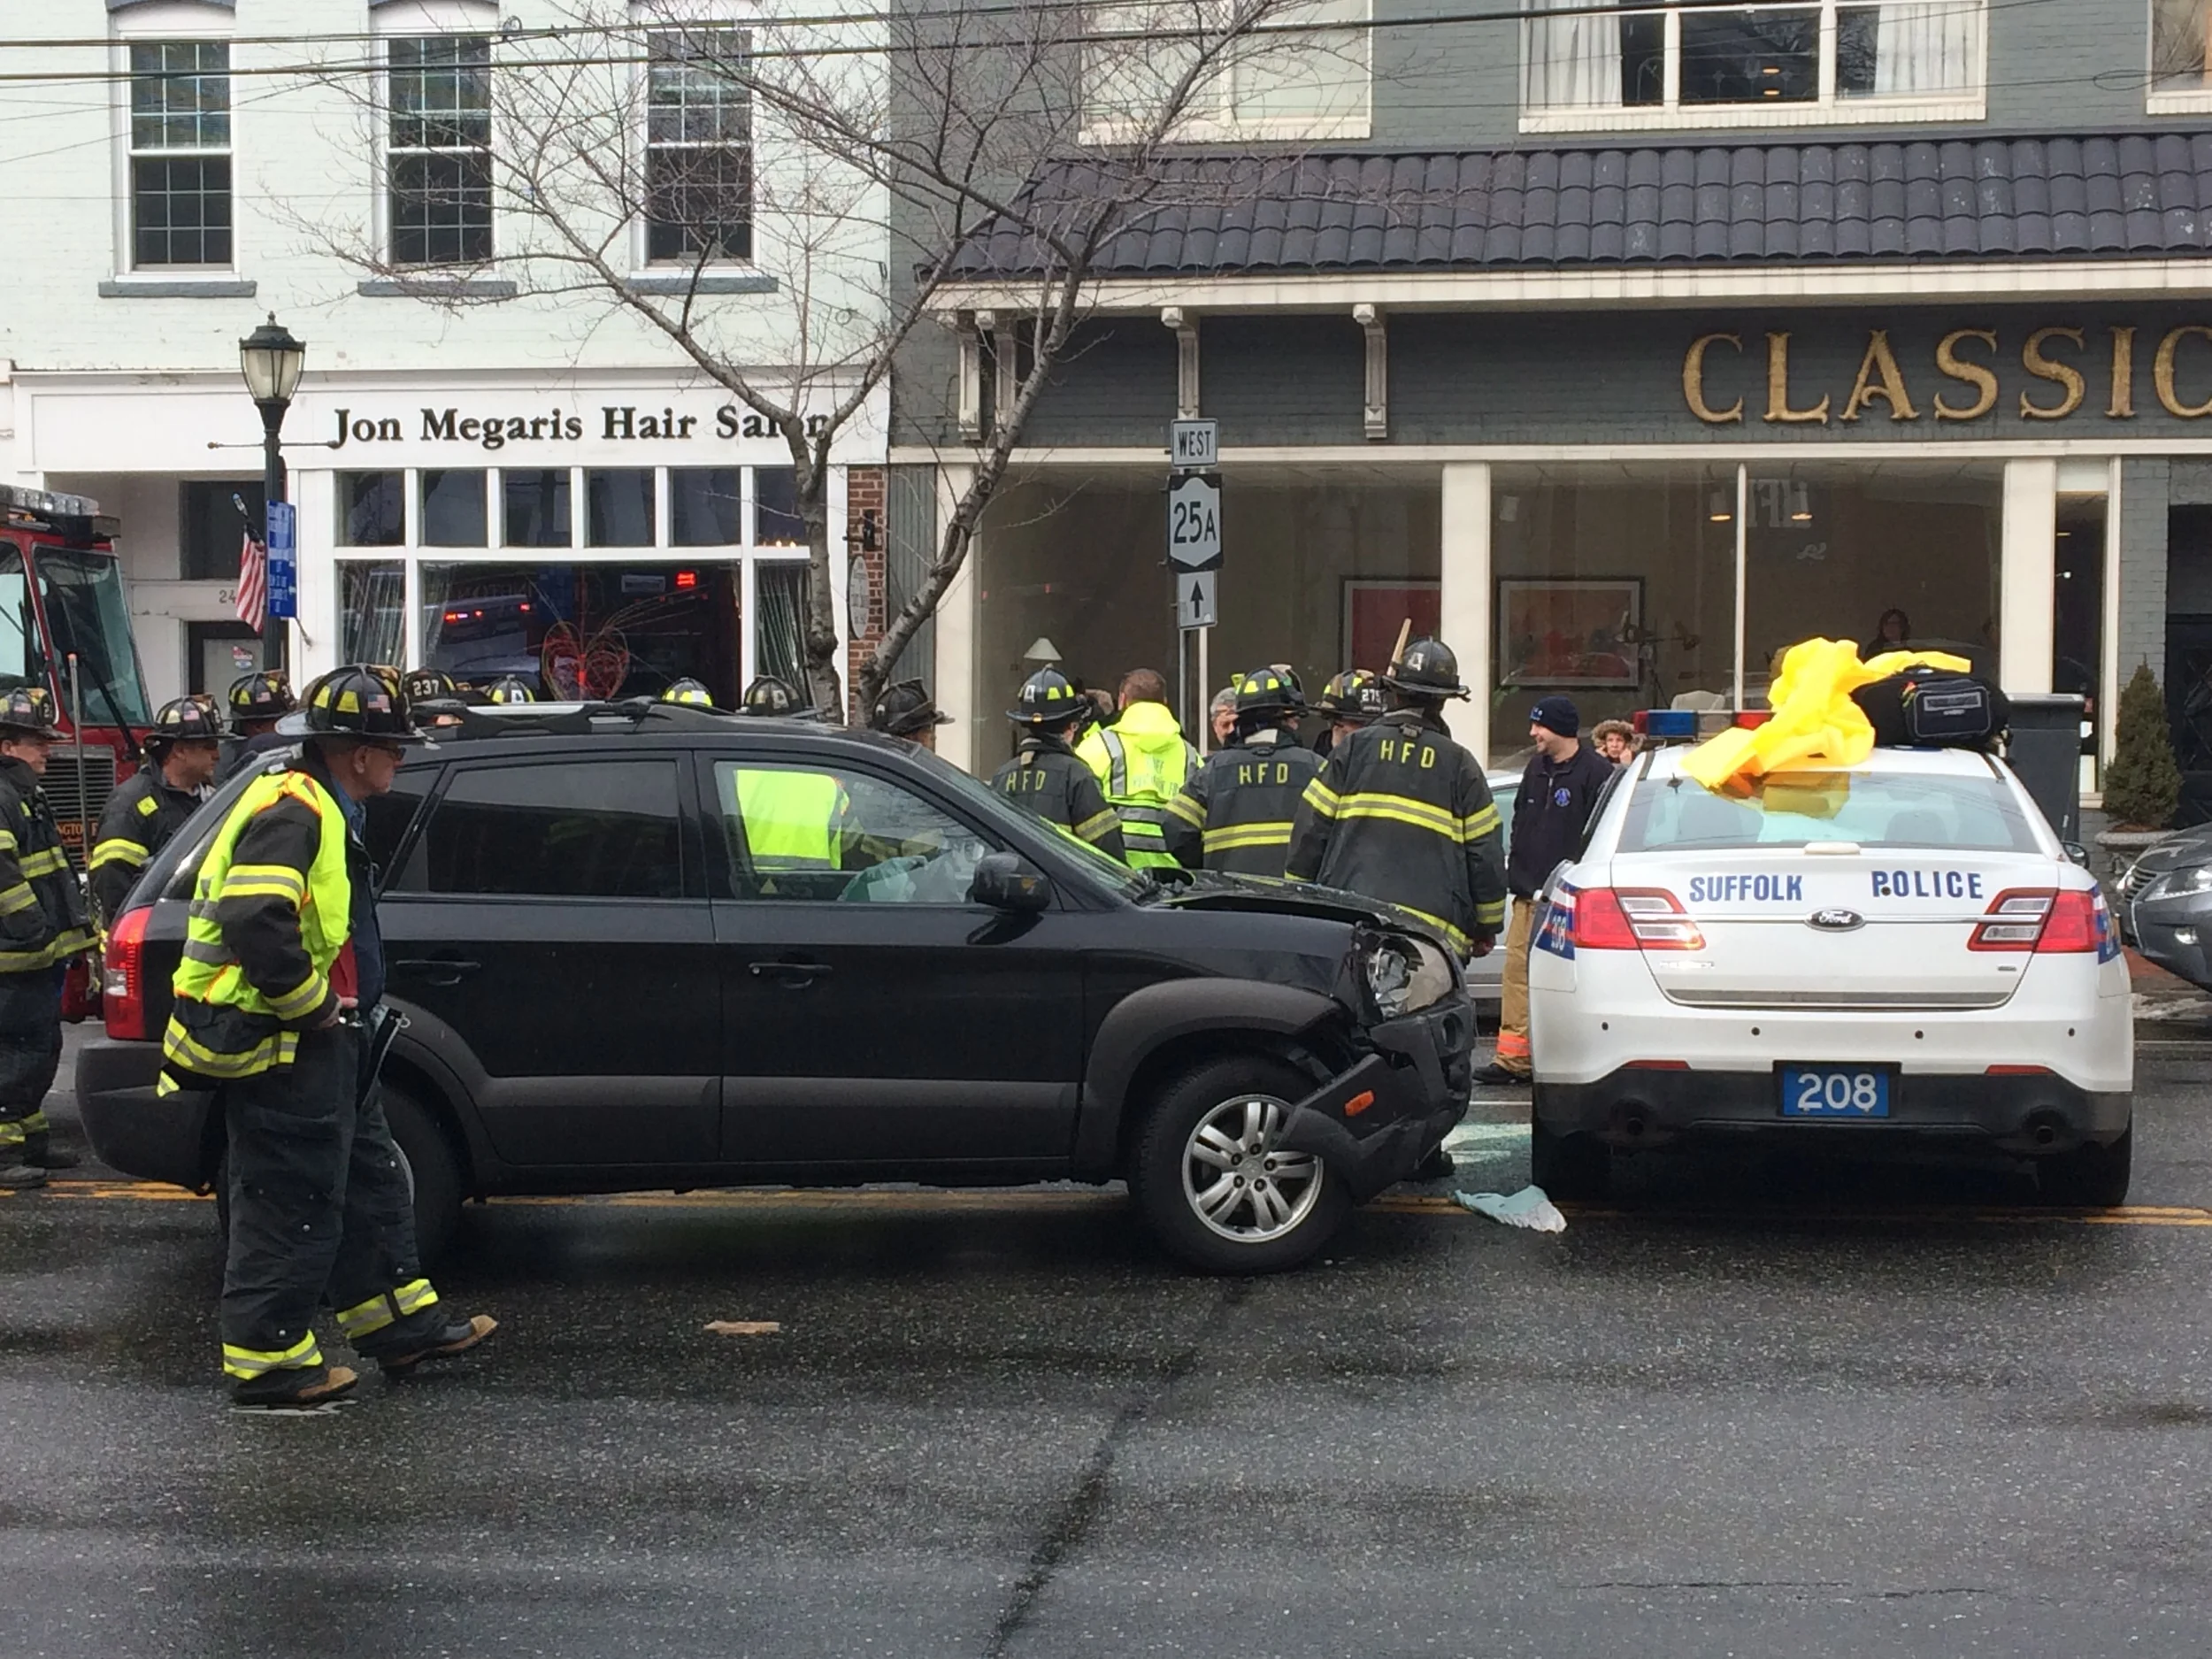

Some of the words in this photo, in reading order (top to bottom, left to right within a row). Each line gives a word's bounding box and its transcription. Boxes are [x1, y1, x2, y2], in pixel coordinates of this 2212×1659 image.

[1682, 325, 2212, 425] CLASSIC
[332, 409, 403, 449] Jon
[419, 408, 583, 449] Megaris
[602, 406, 697, 439] Hair
[716, 405, 830, 440] Saln
[1178, 430, 1211, 457] WEST
[1173, 501, 1217, 544] 25A
[412, 680, 440, 696] 237
[1380, 740, 1435, 769] HFD
[1006, 770, 1047, 792] HFD
[1239, 763, 1289, 785] HFD
[1689, 874, 1803, 902] SUFFOLK
[1871, 870, 1984, 900] POLICE
[1818, 910, 1854, 926] Ford
[1798, 1073, 1878, 1110] 208
